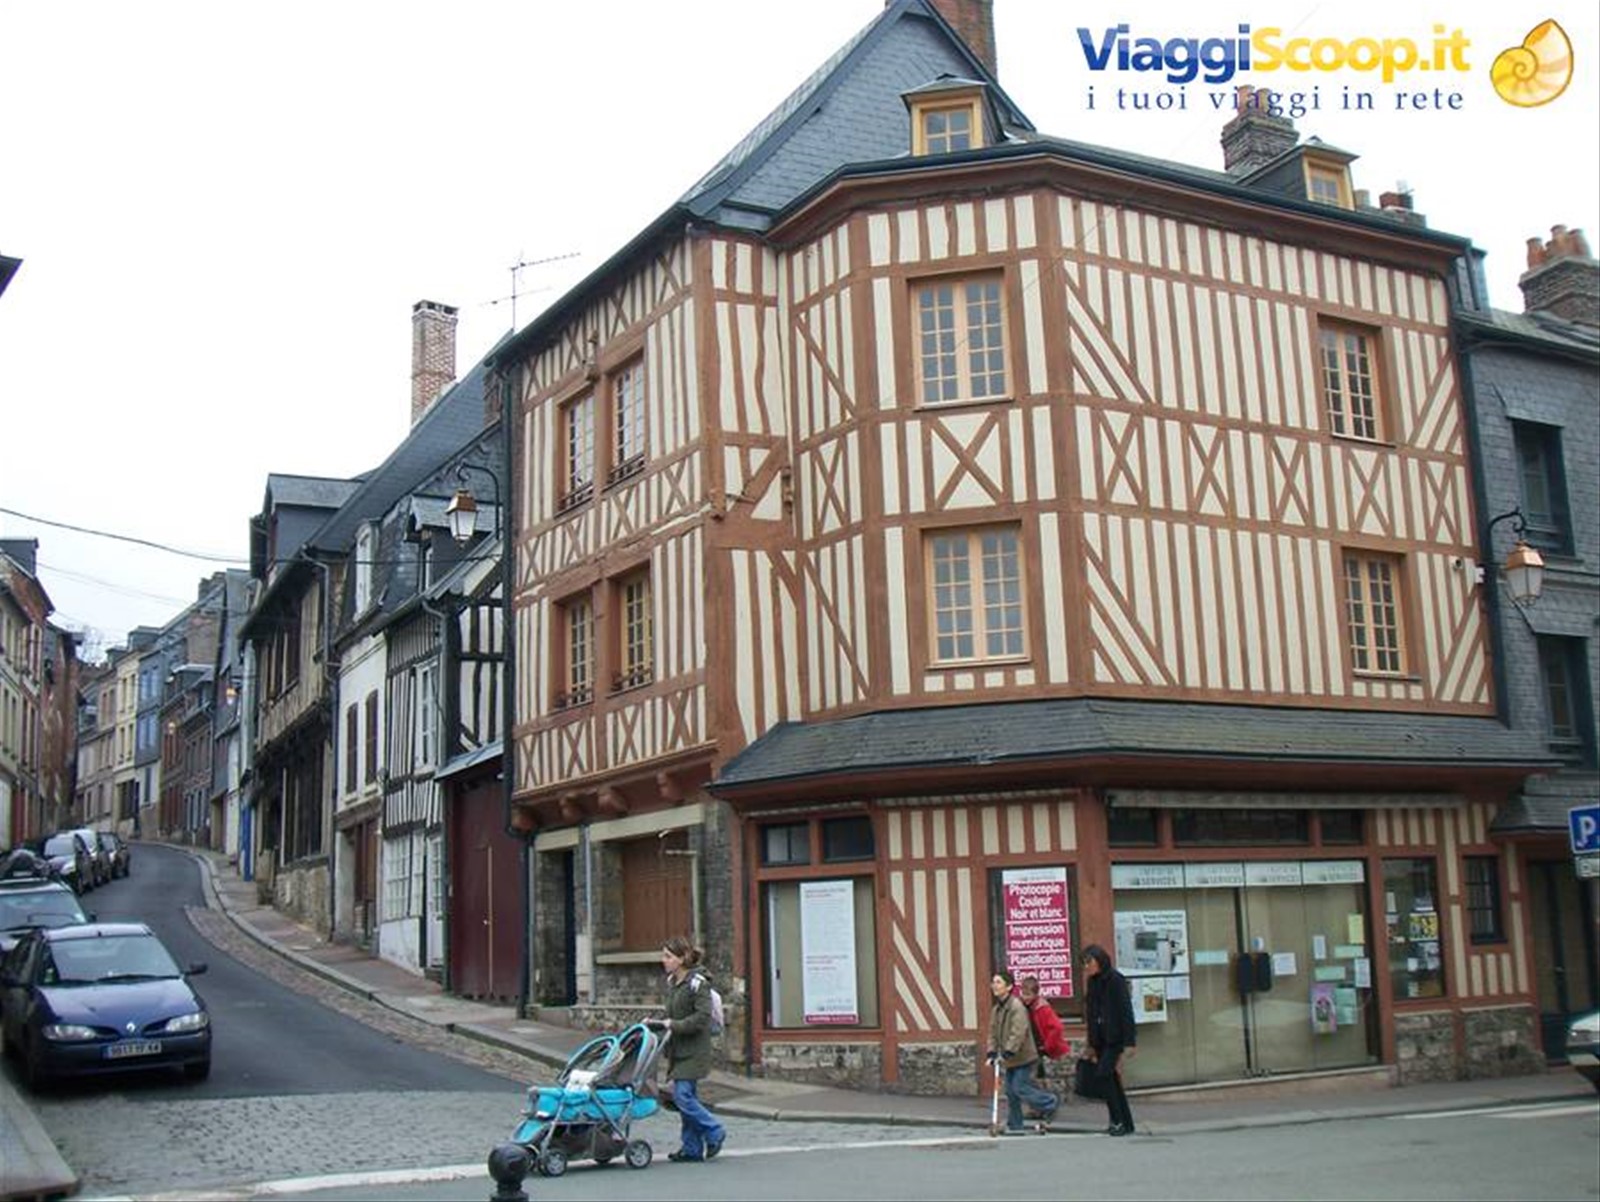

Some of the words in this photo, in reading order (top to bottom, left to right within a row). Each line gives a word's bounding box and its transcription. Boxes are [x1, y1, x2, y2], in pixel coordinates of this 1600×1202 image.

[1009, 883, 1061, 896] Photocopie
[1019, 896, 1052, 907] Couleur
[1010, 908, 1028, 920] Noir
[1030, 908, 1039, 919] et
[1040, 907, 1063, 918] blanc
[1010, 924, 1065, 938] Impression
[1039, 969, 1050, 980] de
